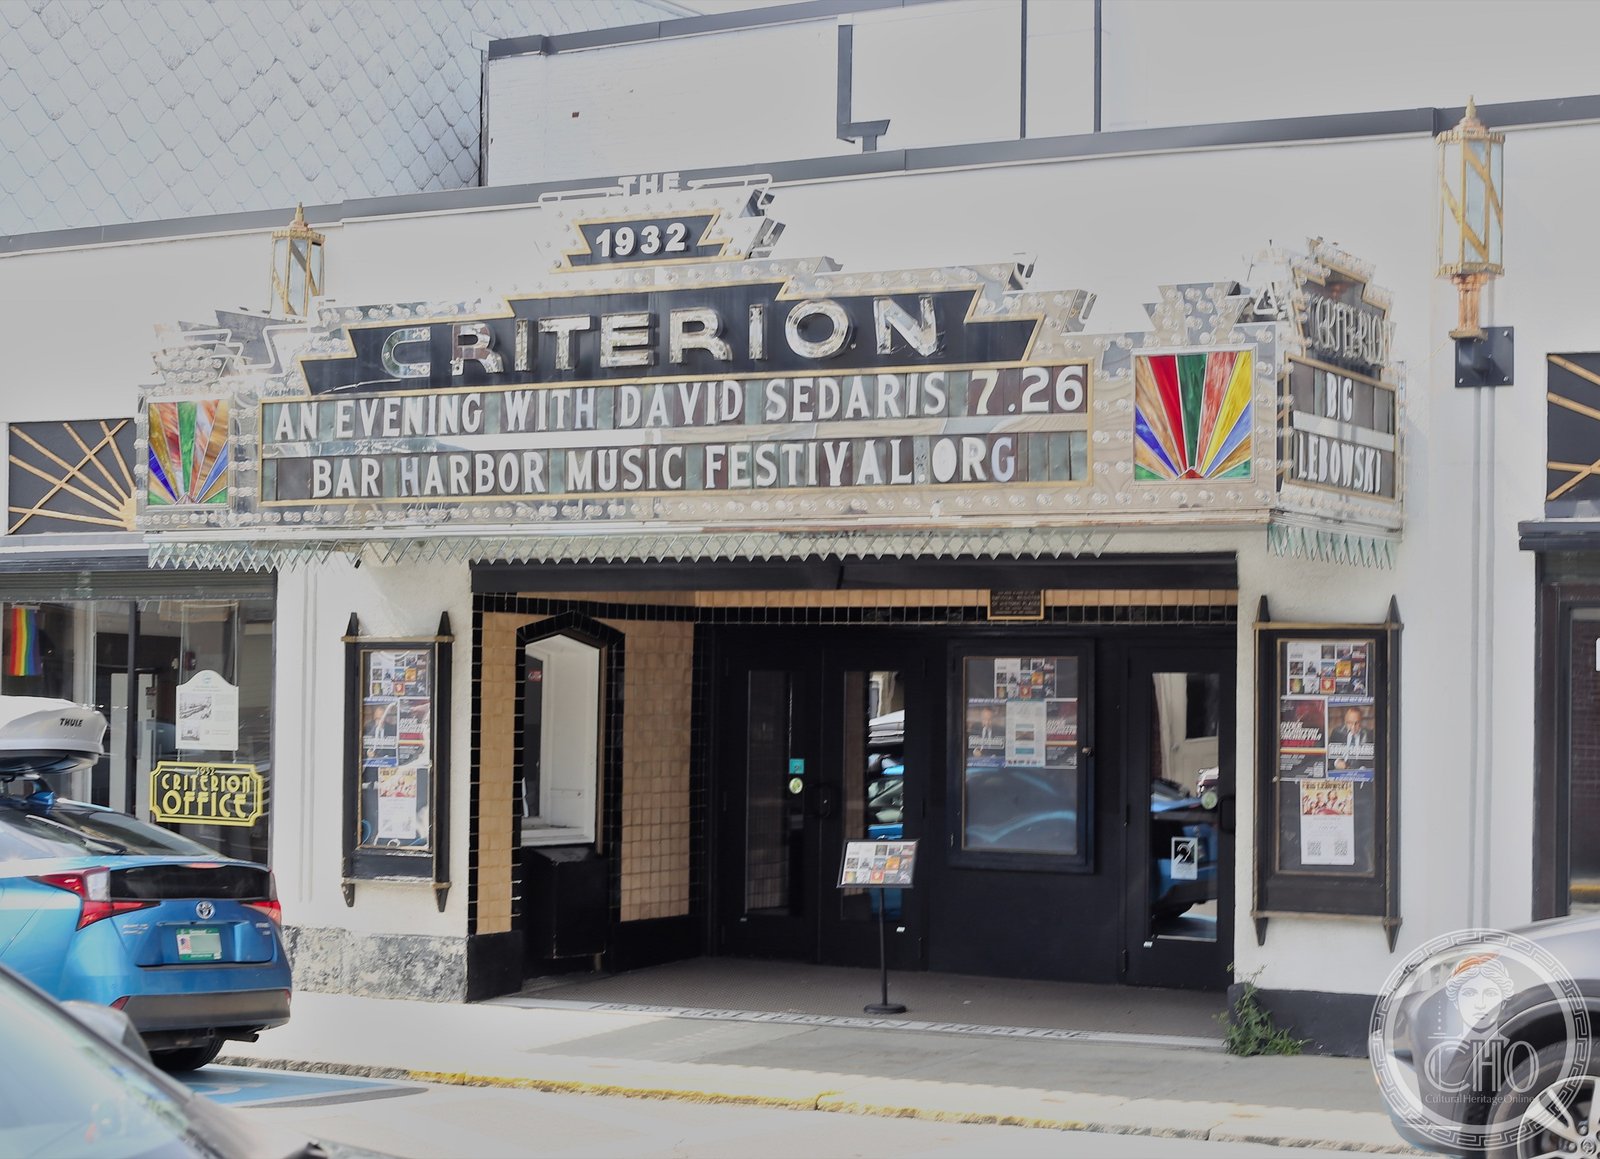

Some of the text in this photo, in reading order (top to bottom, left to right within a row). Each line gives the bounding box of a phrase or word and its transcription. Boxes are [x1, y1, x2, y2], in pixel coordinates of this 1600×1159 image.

[617, 172, 680, 196] THE
[595, 222, 688, 258] 1932
[380, 294, 941, 379] CRITERION
[275, 365, 1084, 441] AN EVENING WITH DAVID SEDARIS 7.26
[1326, 371, 1353, 422] BIG
[313, 437, 1016, 498] BAR HARBOR MUSIC FESTIVAL.ORG
[1298, 431, 1381, 493] LEBOWSKI
[60, 718, 83, 727] THULE
[161, 773, 250, 793] CRITERION
[162, 789, 248, 818] OFFICE
